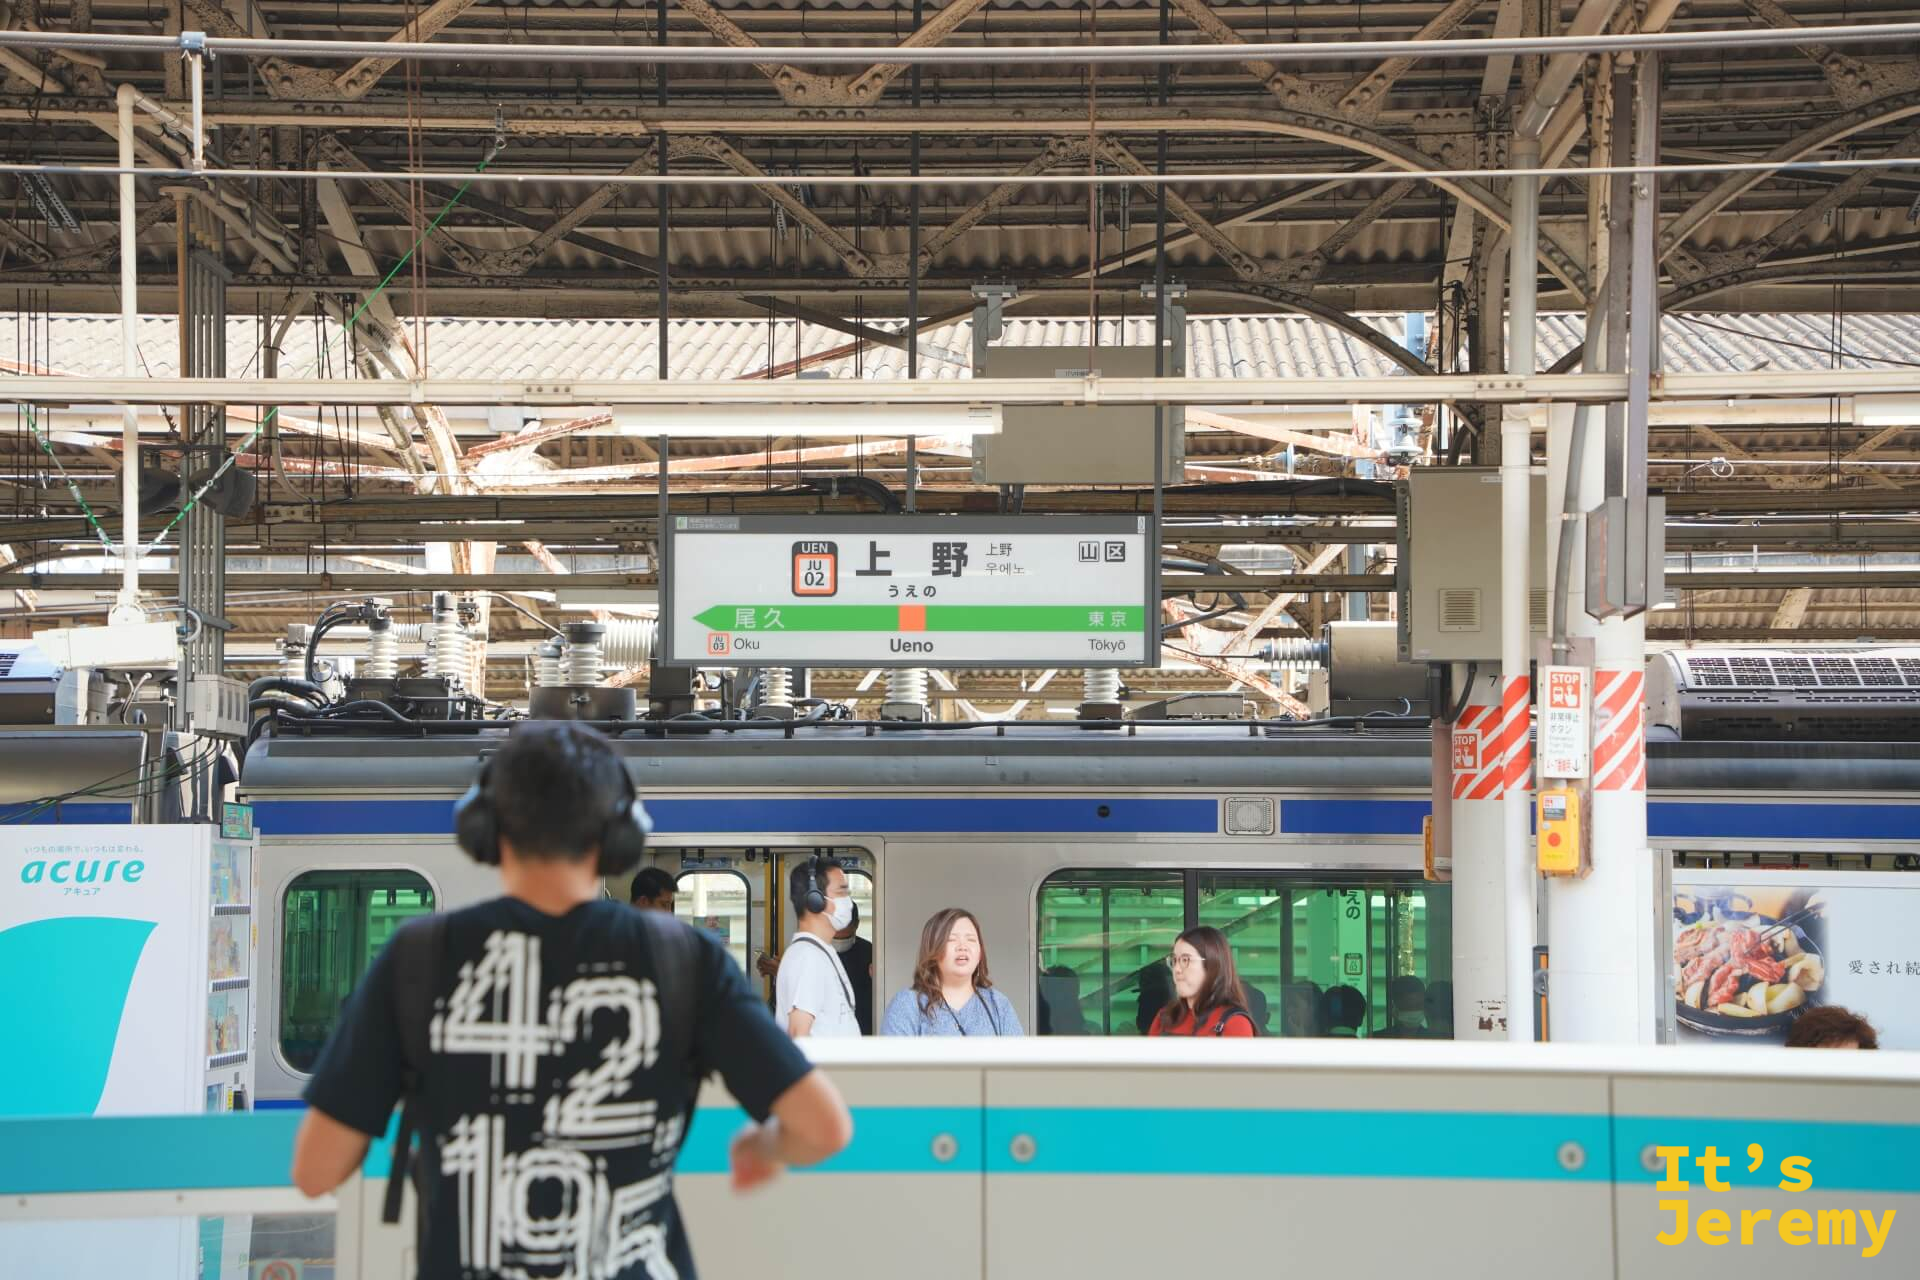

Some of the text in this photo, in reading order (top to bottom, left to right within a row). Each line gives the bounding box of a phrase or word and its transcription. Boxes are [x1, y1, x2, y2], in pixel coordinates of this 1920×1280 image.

[801, 543, 828, 553] UEN
[985, 543, 1013, 557] 上野
[808, 560, 822, 571] JU
[856, 541, 968, 577] 上野
[985, 562, 1025, 576] 우에노
[804, 572, 825, 586] 02
[888, 585, 937, 597] うえの
[735, 608, 785, 629] 尾久
[1088, 611, 1128, 627] 東京
[713, 642, 726, 651] 03
[734, 638, 760, 651] Oku
[890, 638, 934, 653] Ueno
[1551, 673, 1580, 684] STOP
[1454, 736, 1476, 745] STOP
[20, 859, 145, 883] acure
[63, 887, 102, 896] アキュア
